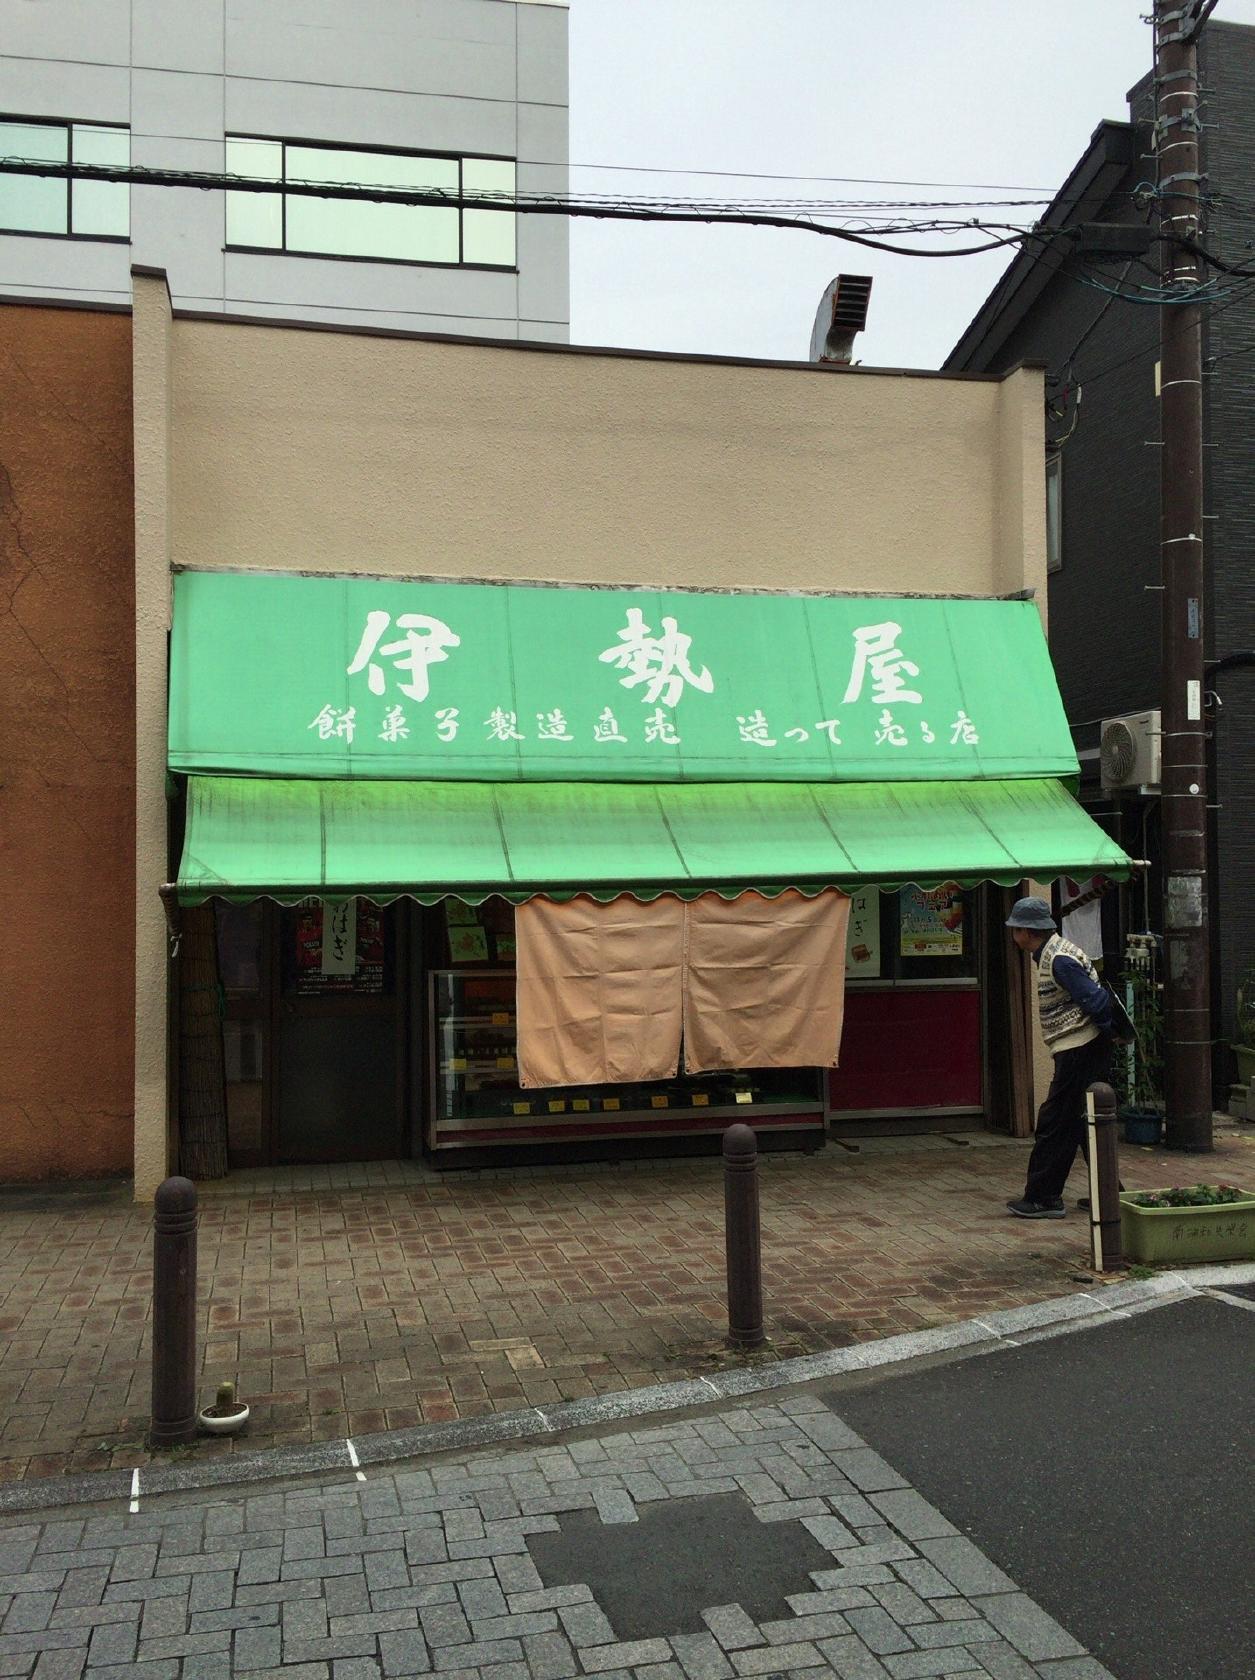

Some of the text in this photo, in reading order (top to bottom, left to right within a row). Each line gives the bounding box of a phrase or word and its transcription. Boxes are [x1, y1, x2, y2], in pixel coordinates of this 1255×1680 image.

[347, 608, 923, 708] 伊勢屋
[308, 704, 980, 746] 餅菓子製造直売 造って売る店
